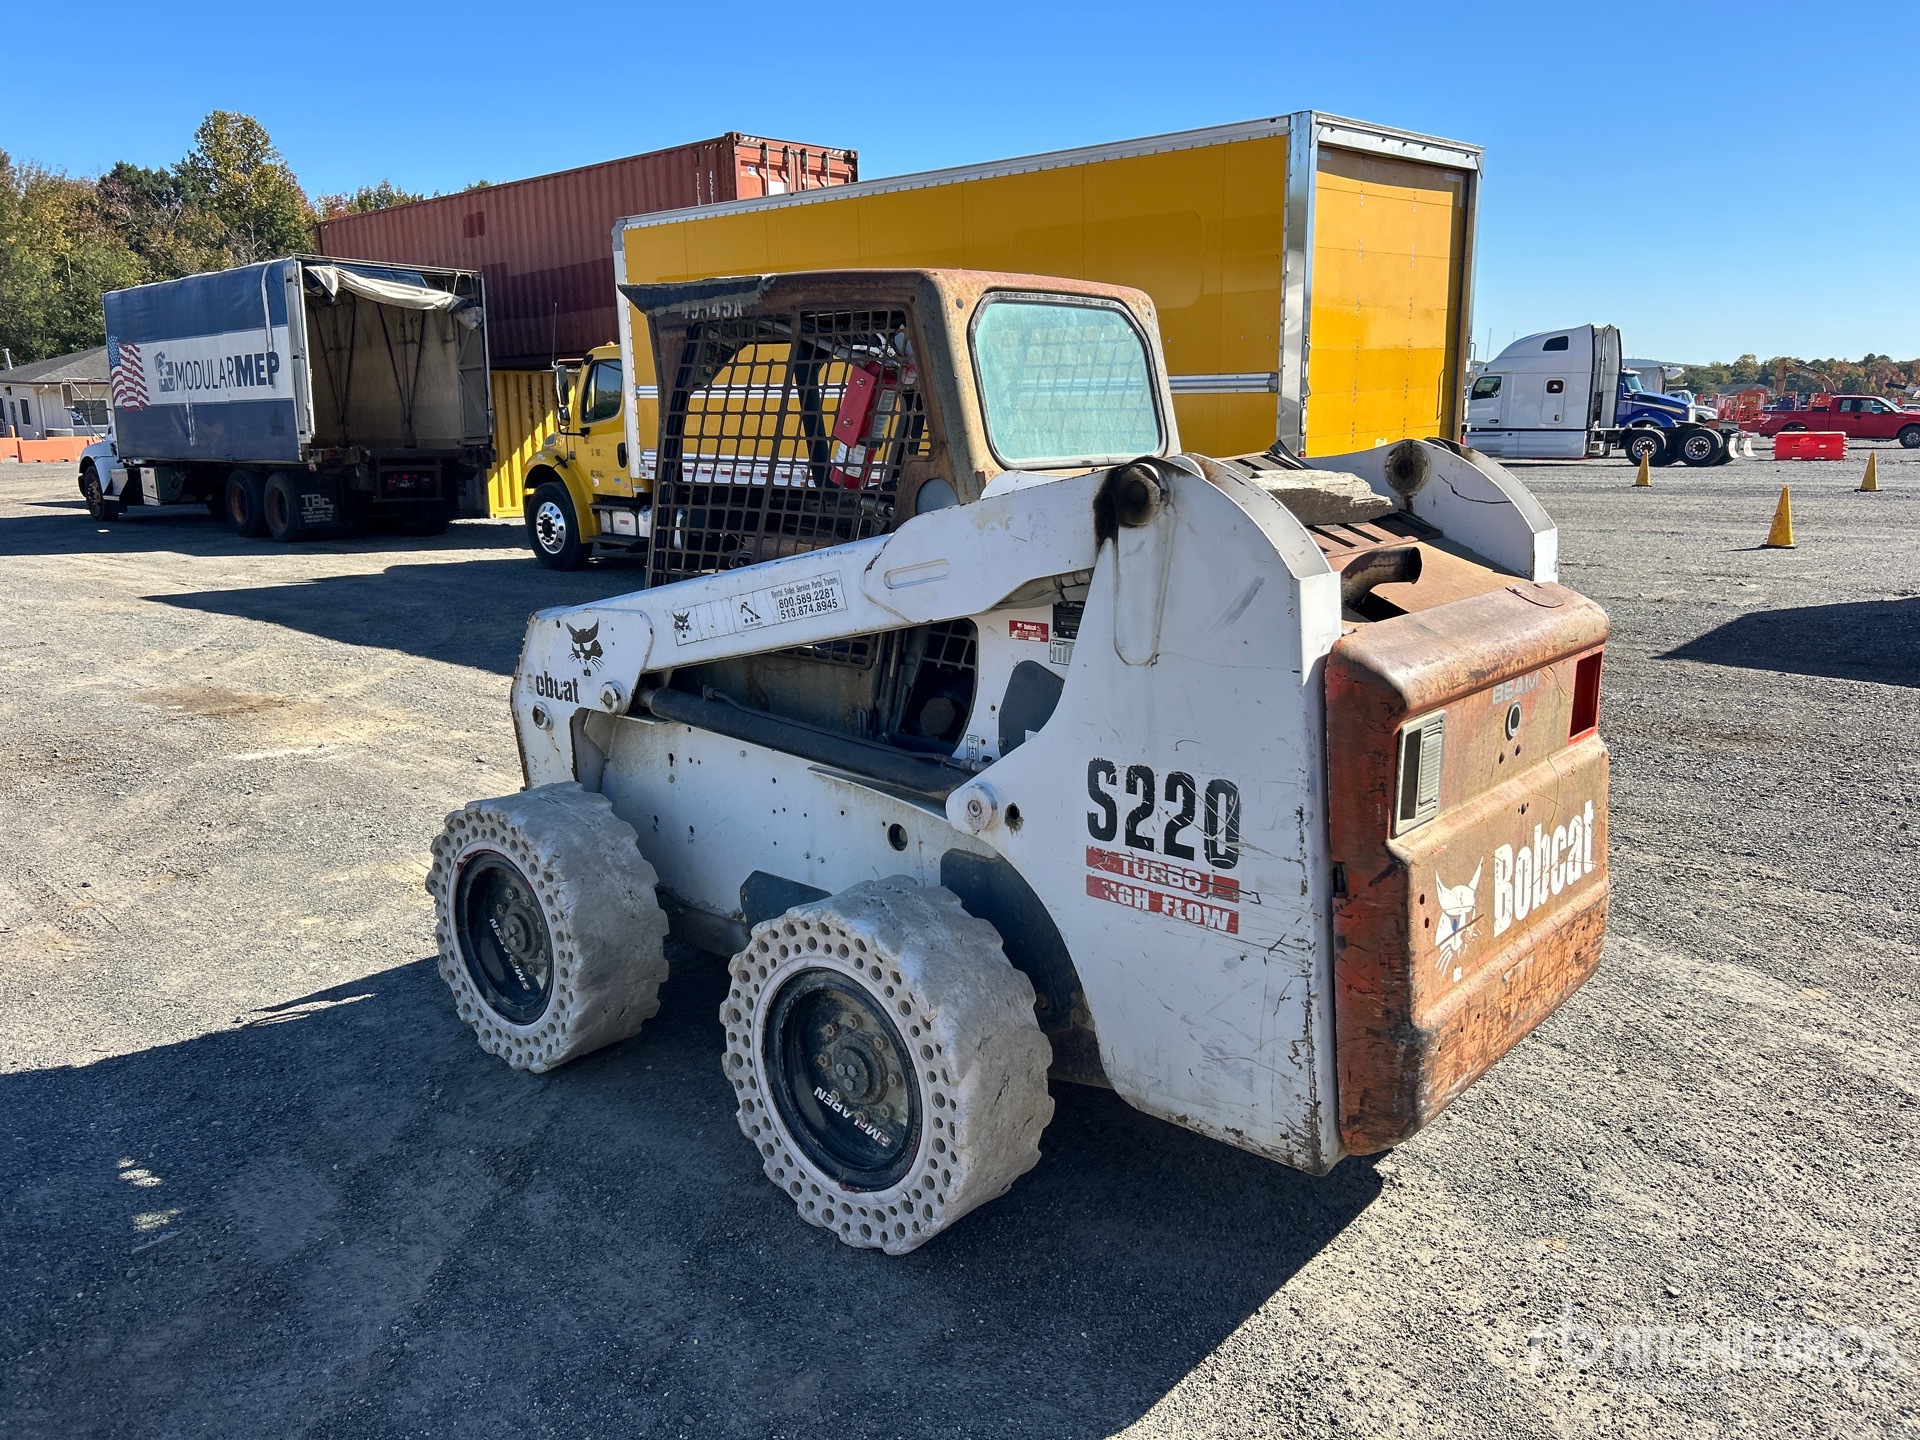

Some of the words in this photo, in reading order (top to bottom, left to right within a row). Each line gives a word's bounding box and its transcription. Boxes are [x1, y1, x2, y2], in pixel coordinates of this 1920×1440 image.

[175, 352, 280, 391] MODULARMEP
[779, 587, 835, 609] 800.589.2281
[796, 583, 810, 593] Service
[780, 598, 838, 619] 513.874.8945
[1492, 671, 1539, 705] BEAM
[1087, 757, 1240, 869] S220
[1494, 799, 1596, 938] Bobcat
[1161, 895, 1230, 932] FLOW
